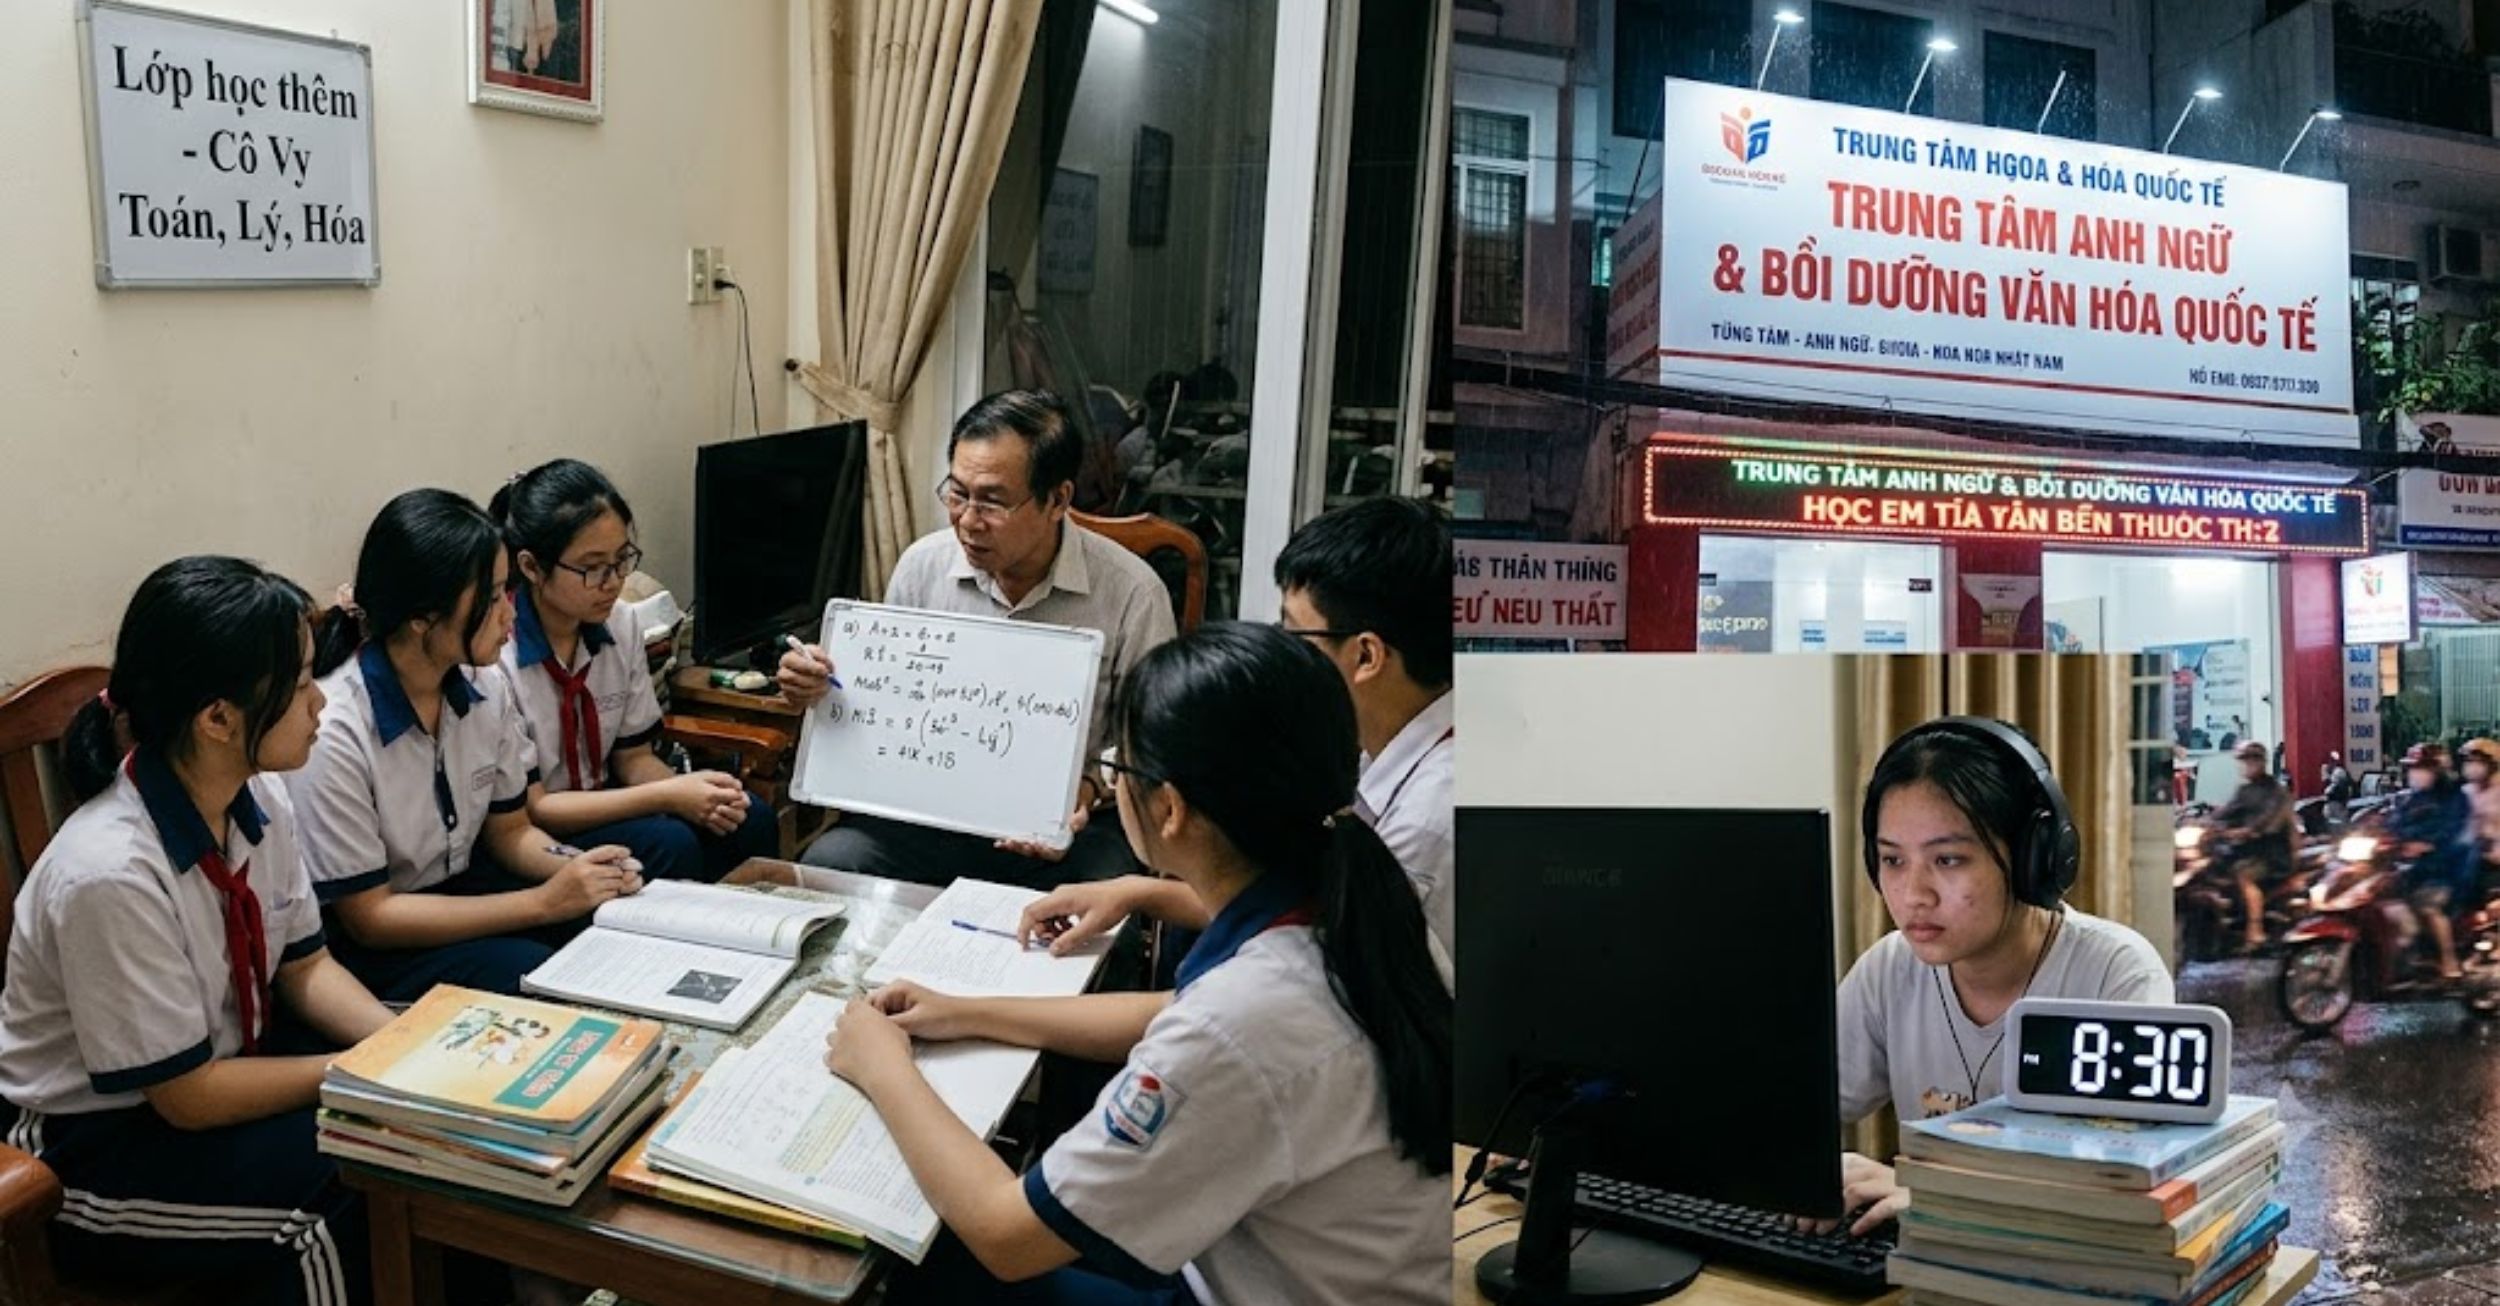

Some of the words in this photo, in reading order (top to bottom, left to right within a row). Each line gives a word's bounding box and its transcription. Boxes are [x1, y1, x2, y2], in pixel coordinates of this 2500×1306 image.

[112, 44, 193, 108] Lớp
[206, 57, 267, 118] học
[278, 69, 359, 120] thêm
[208, 129, 258, 175] Cô
[268, 135, 312, 188] Vy
[1833, 126, 1918, 165] TRUNG
[1925, 136, 1978, 173] TÂM
[2057, 159, 2074, 187] &
[2082, 161, 2127, 193] HÓA
[2135, 167, 2193, 203] QUỐC
[2200, 175, 2228, 208] TẾ
[119, 192, 226, 248] Toán,
[236, 199, 293, 253] Lý,
[303, 203, 366, 246] Hóa
[1827, 180, 1962, 243] TRUNG
[1975, 194, 2057, 256] TÂM
[2069, 213, 2145, 265] ANH
[2157, 222, 2233, 276] NGỮ
[1712, 243, 1746, 294] &
[1761, 235, 1833, 302] BỒI
[1847, 253, 1987, 319] DƯỠNG
[2000, 267, 2077, 327] VĂN
[2089, 279, 2162, 336] HÓA
[2174, 286, 2268, 346] QUỐC
[2277, 295, 2319, 353] TẾ
[1804, 331, 1835, 351] ANH
[1731, 459, 1821, 485] TRUNG
[1884, 469, 1937, 492] ANH
[1999, 476, 2020, 497] &
[1803, 495, 1873, 529] HỌC
[1880, 499, 1926, 526] EM
[2070, 1021, 2208, 1102] 8:30
